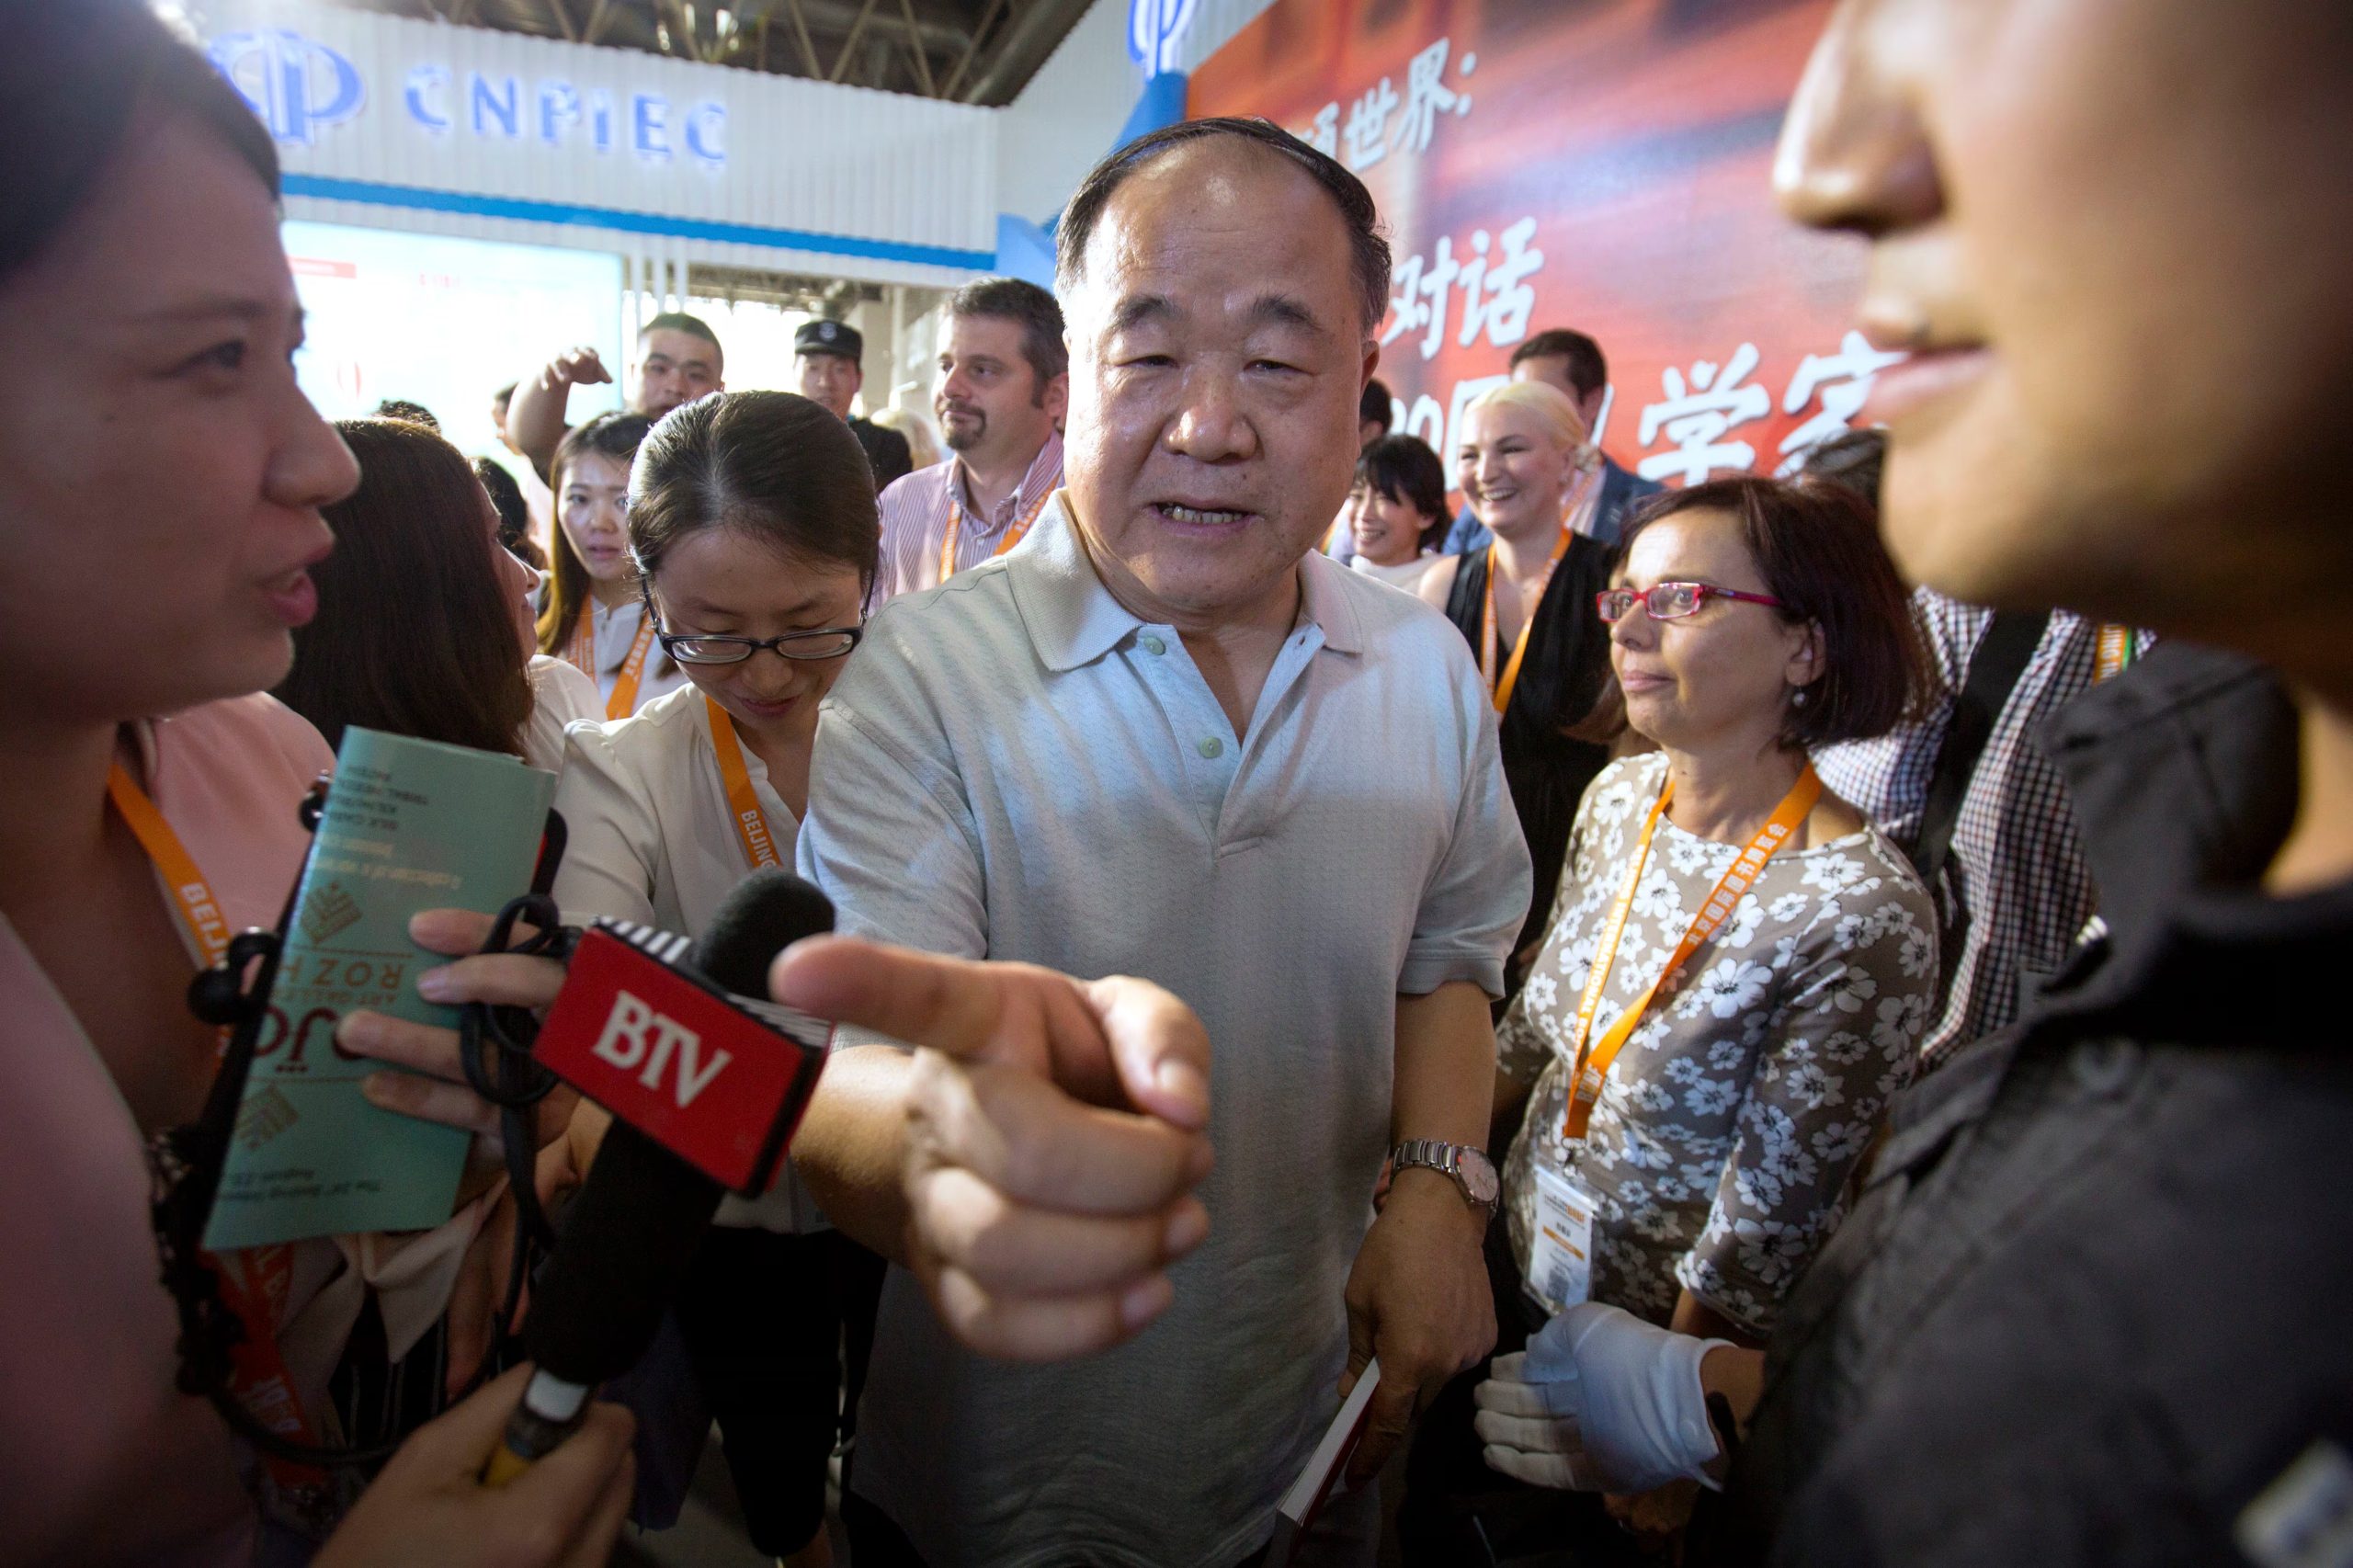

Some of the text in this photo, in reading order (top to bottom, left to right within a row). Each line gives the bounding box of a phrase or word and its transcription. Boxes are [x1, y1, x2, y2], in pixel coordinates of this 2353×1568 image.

[404, 66, 728, 164] CNPIEC
[1381, 216, 1544, 358] 对话
[1581, 900, 1629, 1014] INTERNATIONAL
[593, 990, 733, 1108] BTV
